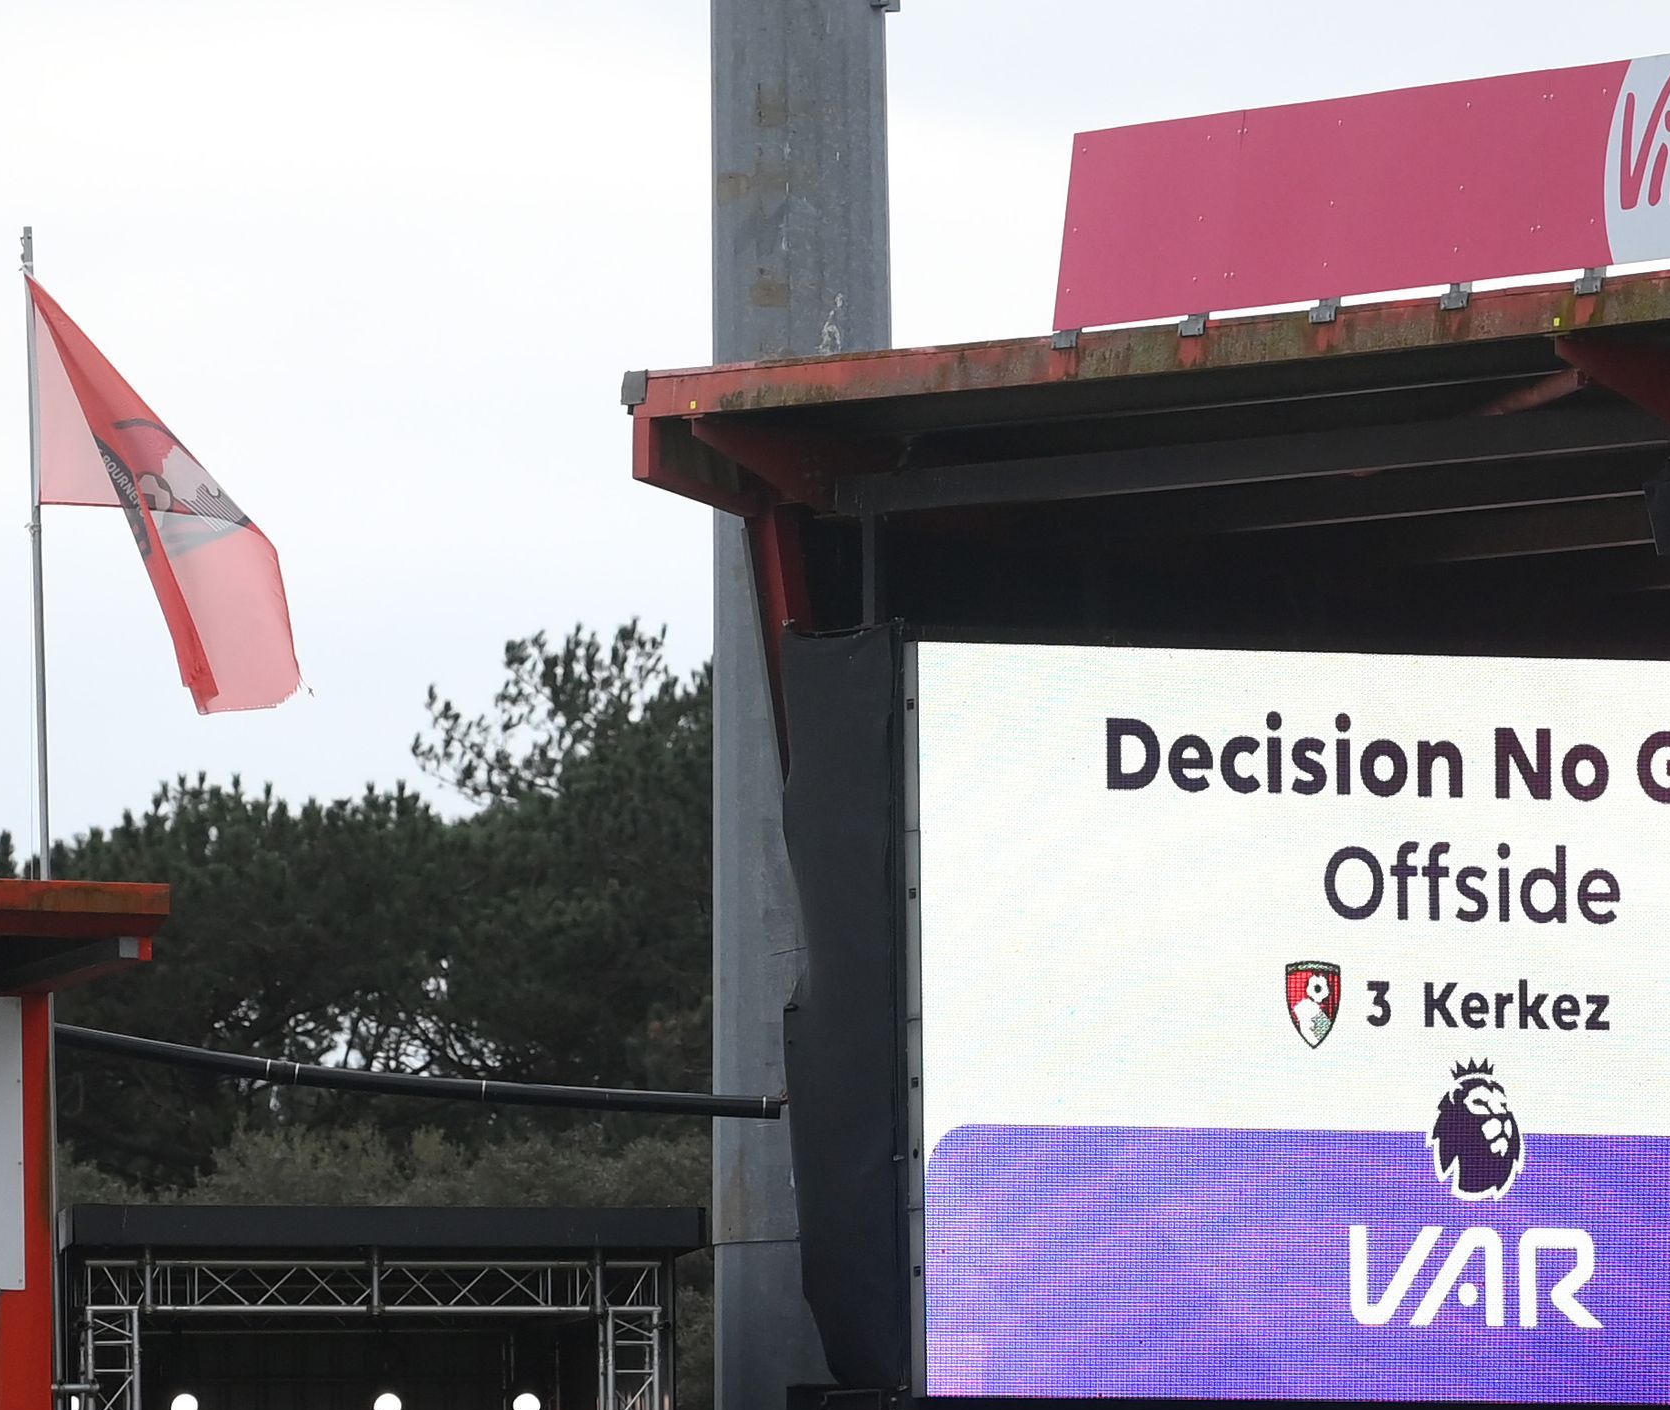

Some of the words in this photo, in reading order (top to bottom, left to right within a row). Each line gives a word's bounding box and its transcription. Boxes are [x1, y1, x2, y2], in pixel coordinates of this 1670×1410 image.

[1106, 712, 1463, 798] Decision
[1495, 727, 1610, 803] No
[1324, 842, 1622, 926] Offside
[1366, 980, 1392, 1028] 3
[1424, 981, 1611, 1032] Kerkez
[1349, 1224, 1604, 1329] VAR
